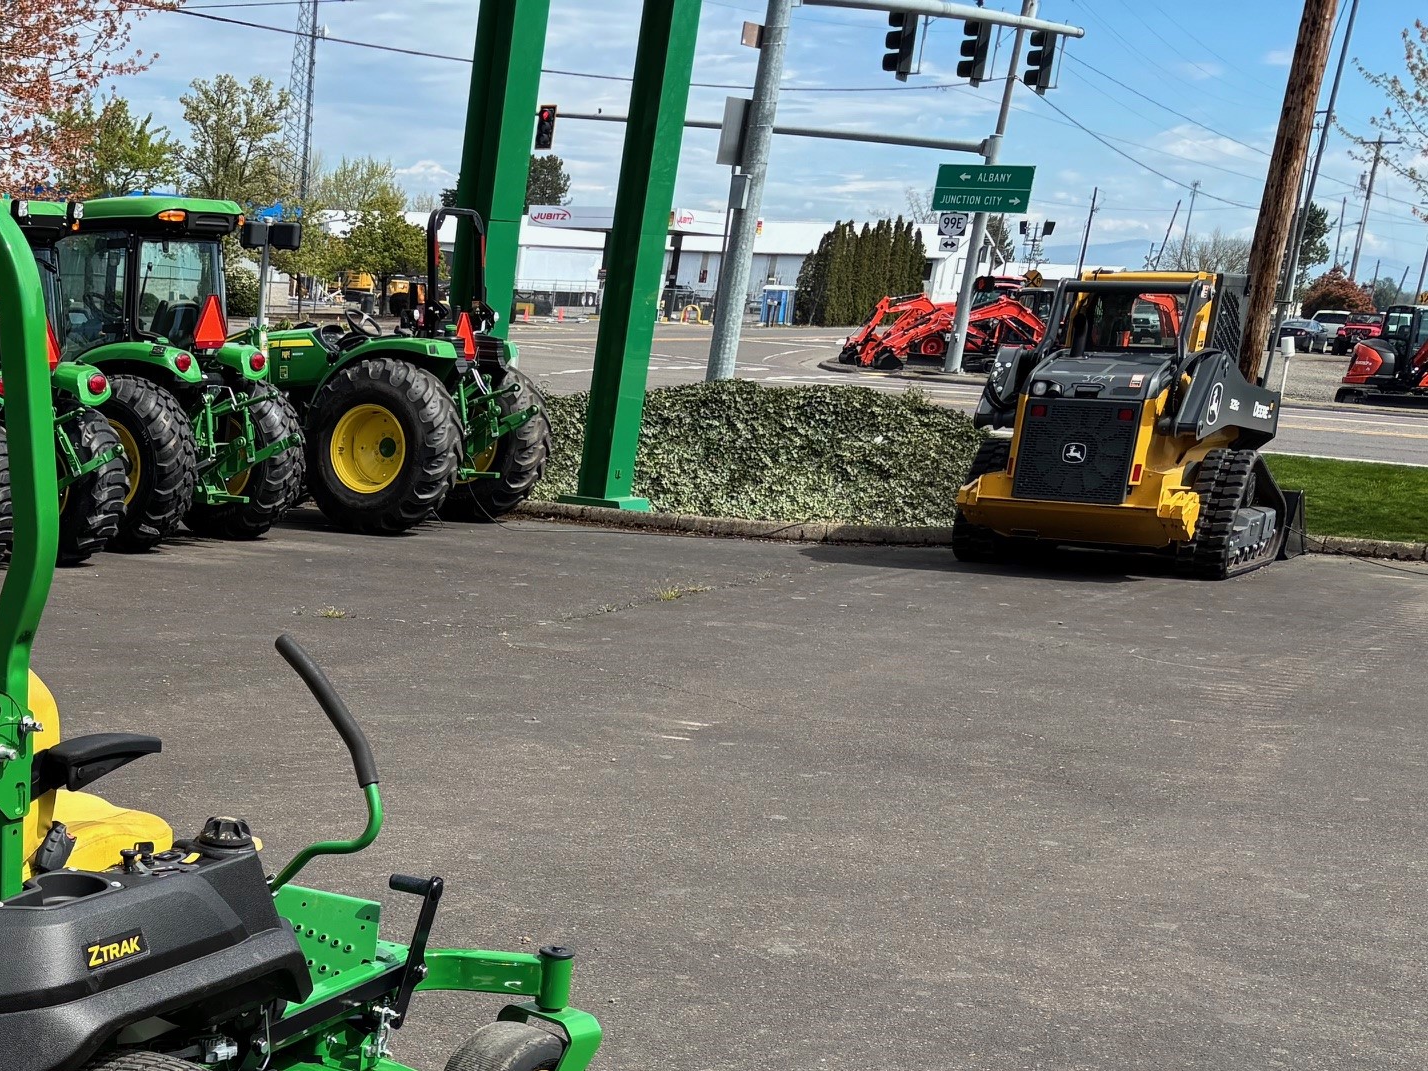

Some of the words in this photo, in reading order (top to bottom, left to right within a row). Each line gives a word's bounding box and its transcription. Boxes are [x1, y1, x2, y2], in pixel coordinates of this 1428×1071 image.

[977, 172, 1012, 182] ALBANY
[940, 194, 981, 205] JUNCTION
[983, 196, 1003, 205] CITY
[534, 211, 567, 221] JUBITZ
[677, 216, 692, 225] JUBITZ
[943, 217, 964, 229] 99E
[87, 935, 141, 967] ZTRAK
